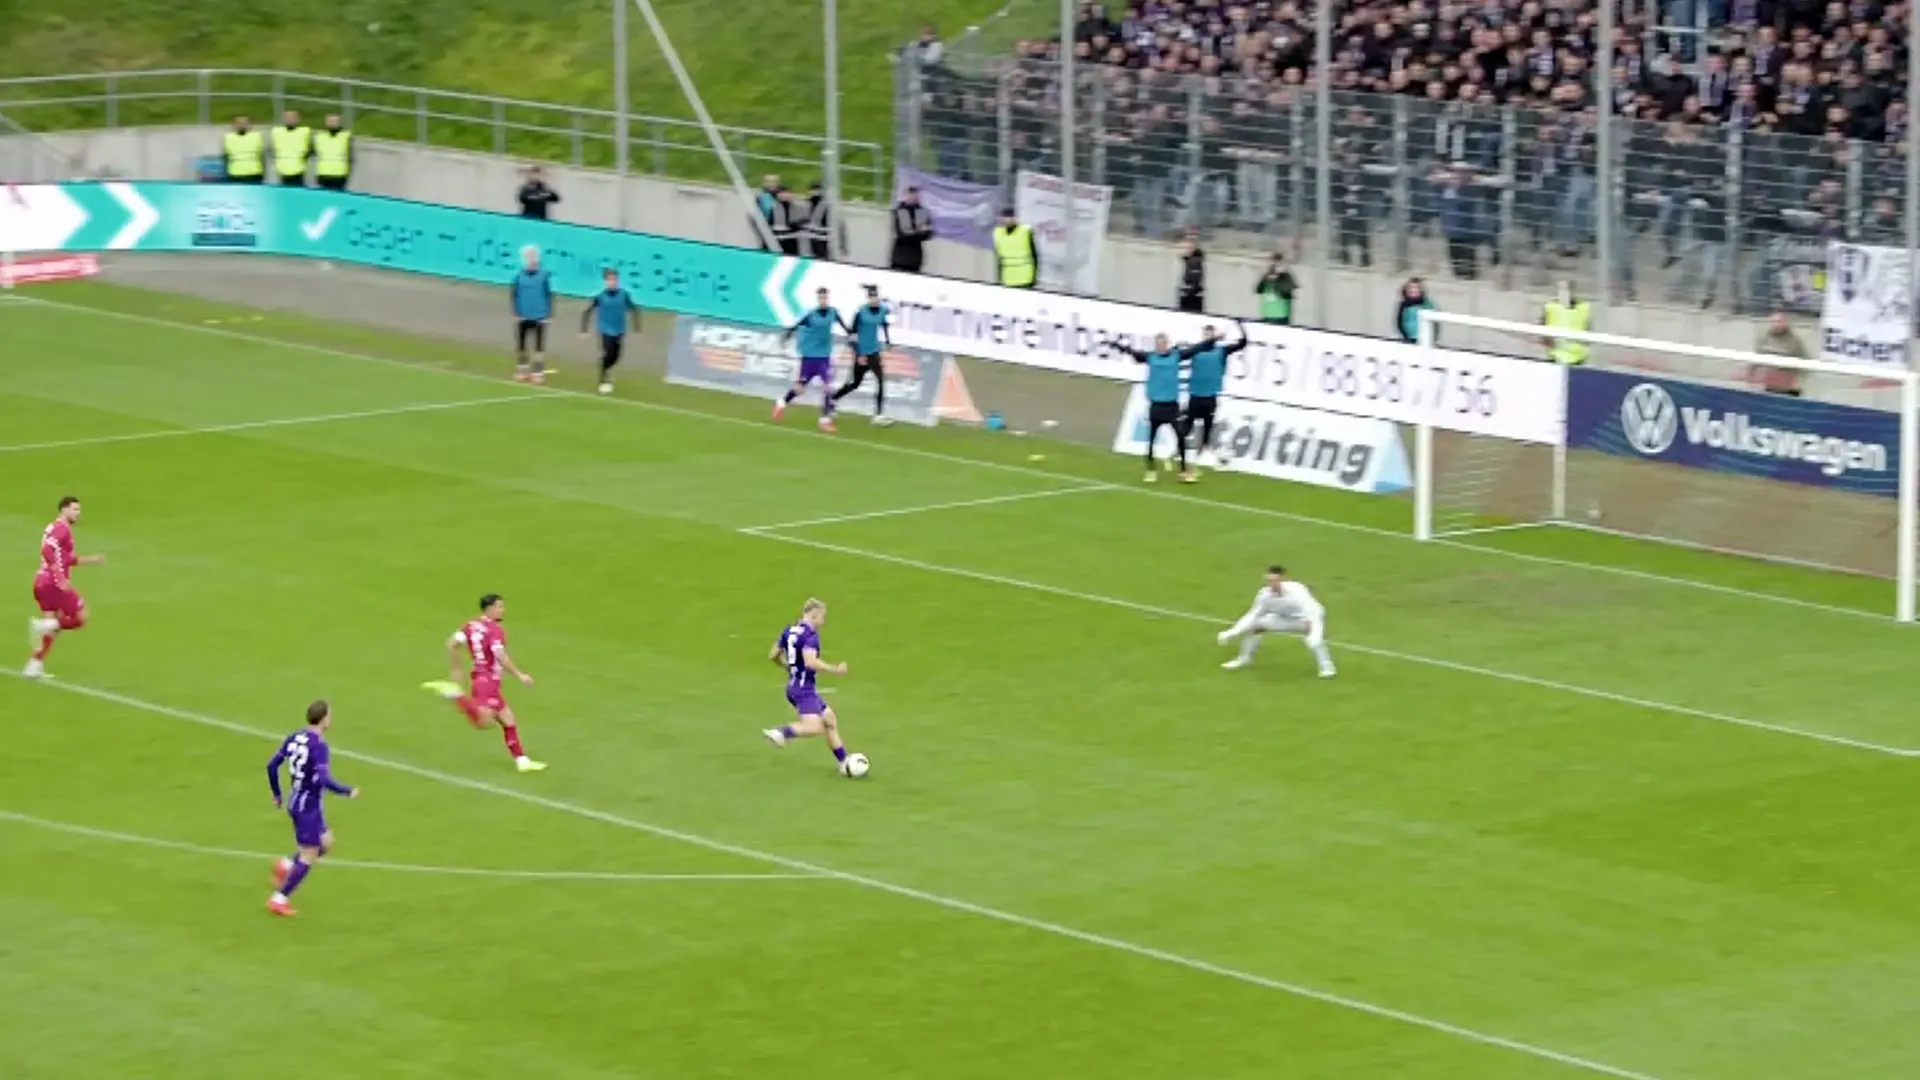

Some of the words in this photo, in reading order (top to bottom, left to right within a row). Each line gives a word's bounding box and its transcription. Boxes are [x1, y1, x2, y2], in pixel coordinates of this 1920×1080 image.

[342, 208, 426, 262] Gegen
[651, 253, 731, 304] Beine
[1680, 406, 1888, 477] Volkswagen
[286, 741, 310, 779] 22
